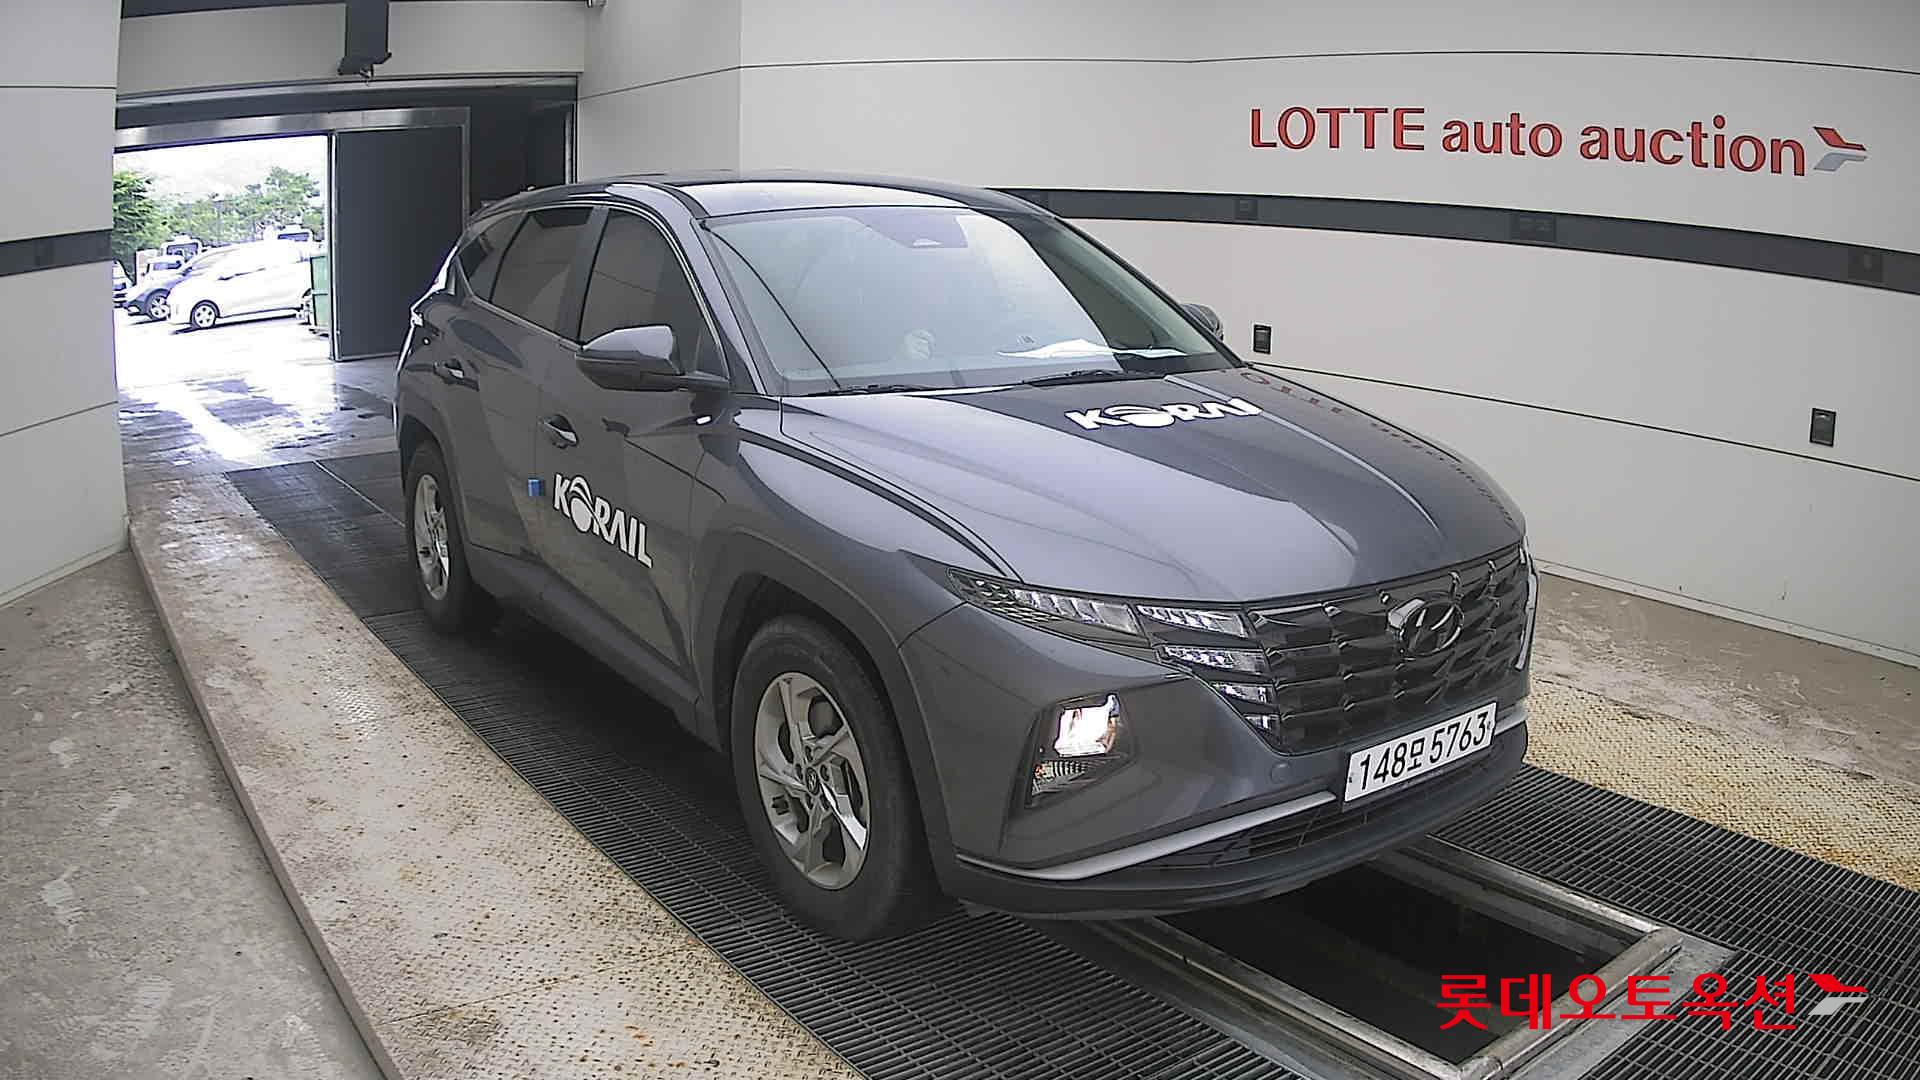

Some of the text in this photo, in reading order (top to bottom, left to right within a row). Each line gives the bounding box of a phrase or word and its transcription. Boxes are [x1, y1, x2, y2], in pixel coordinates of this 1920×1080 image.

[1250, 107, 1806, 177] LOTTE auto auction
[1064, 397, 1264, 430] KORAI
[553, 473, 653, 569] KORAIL
